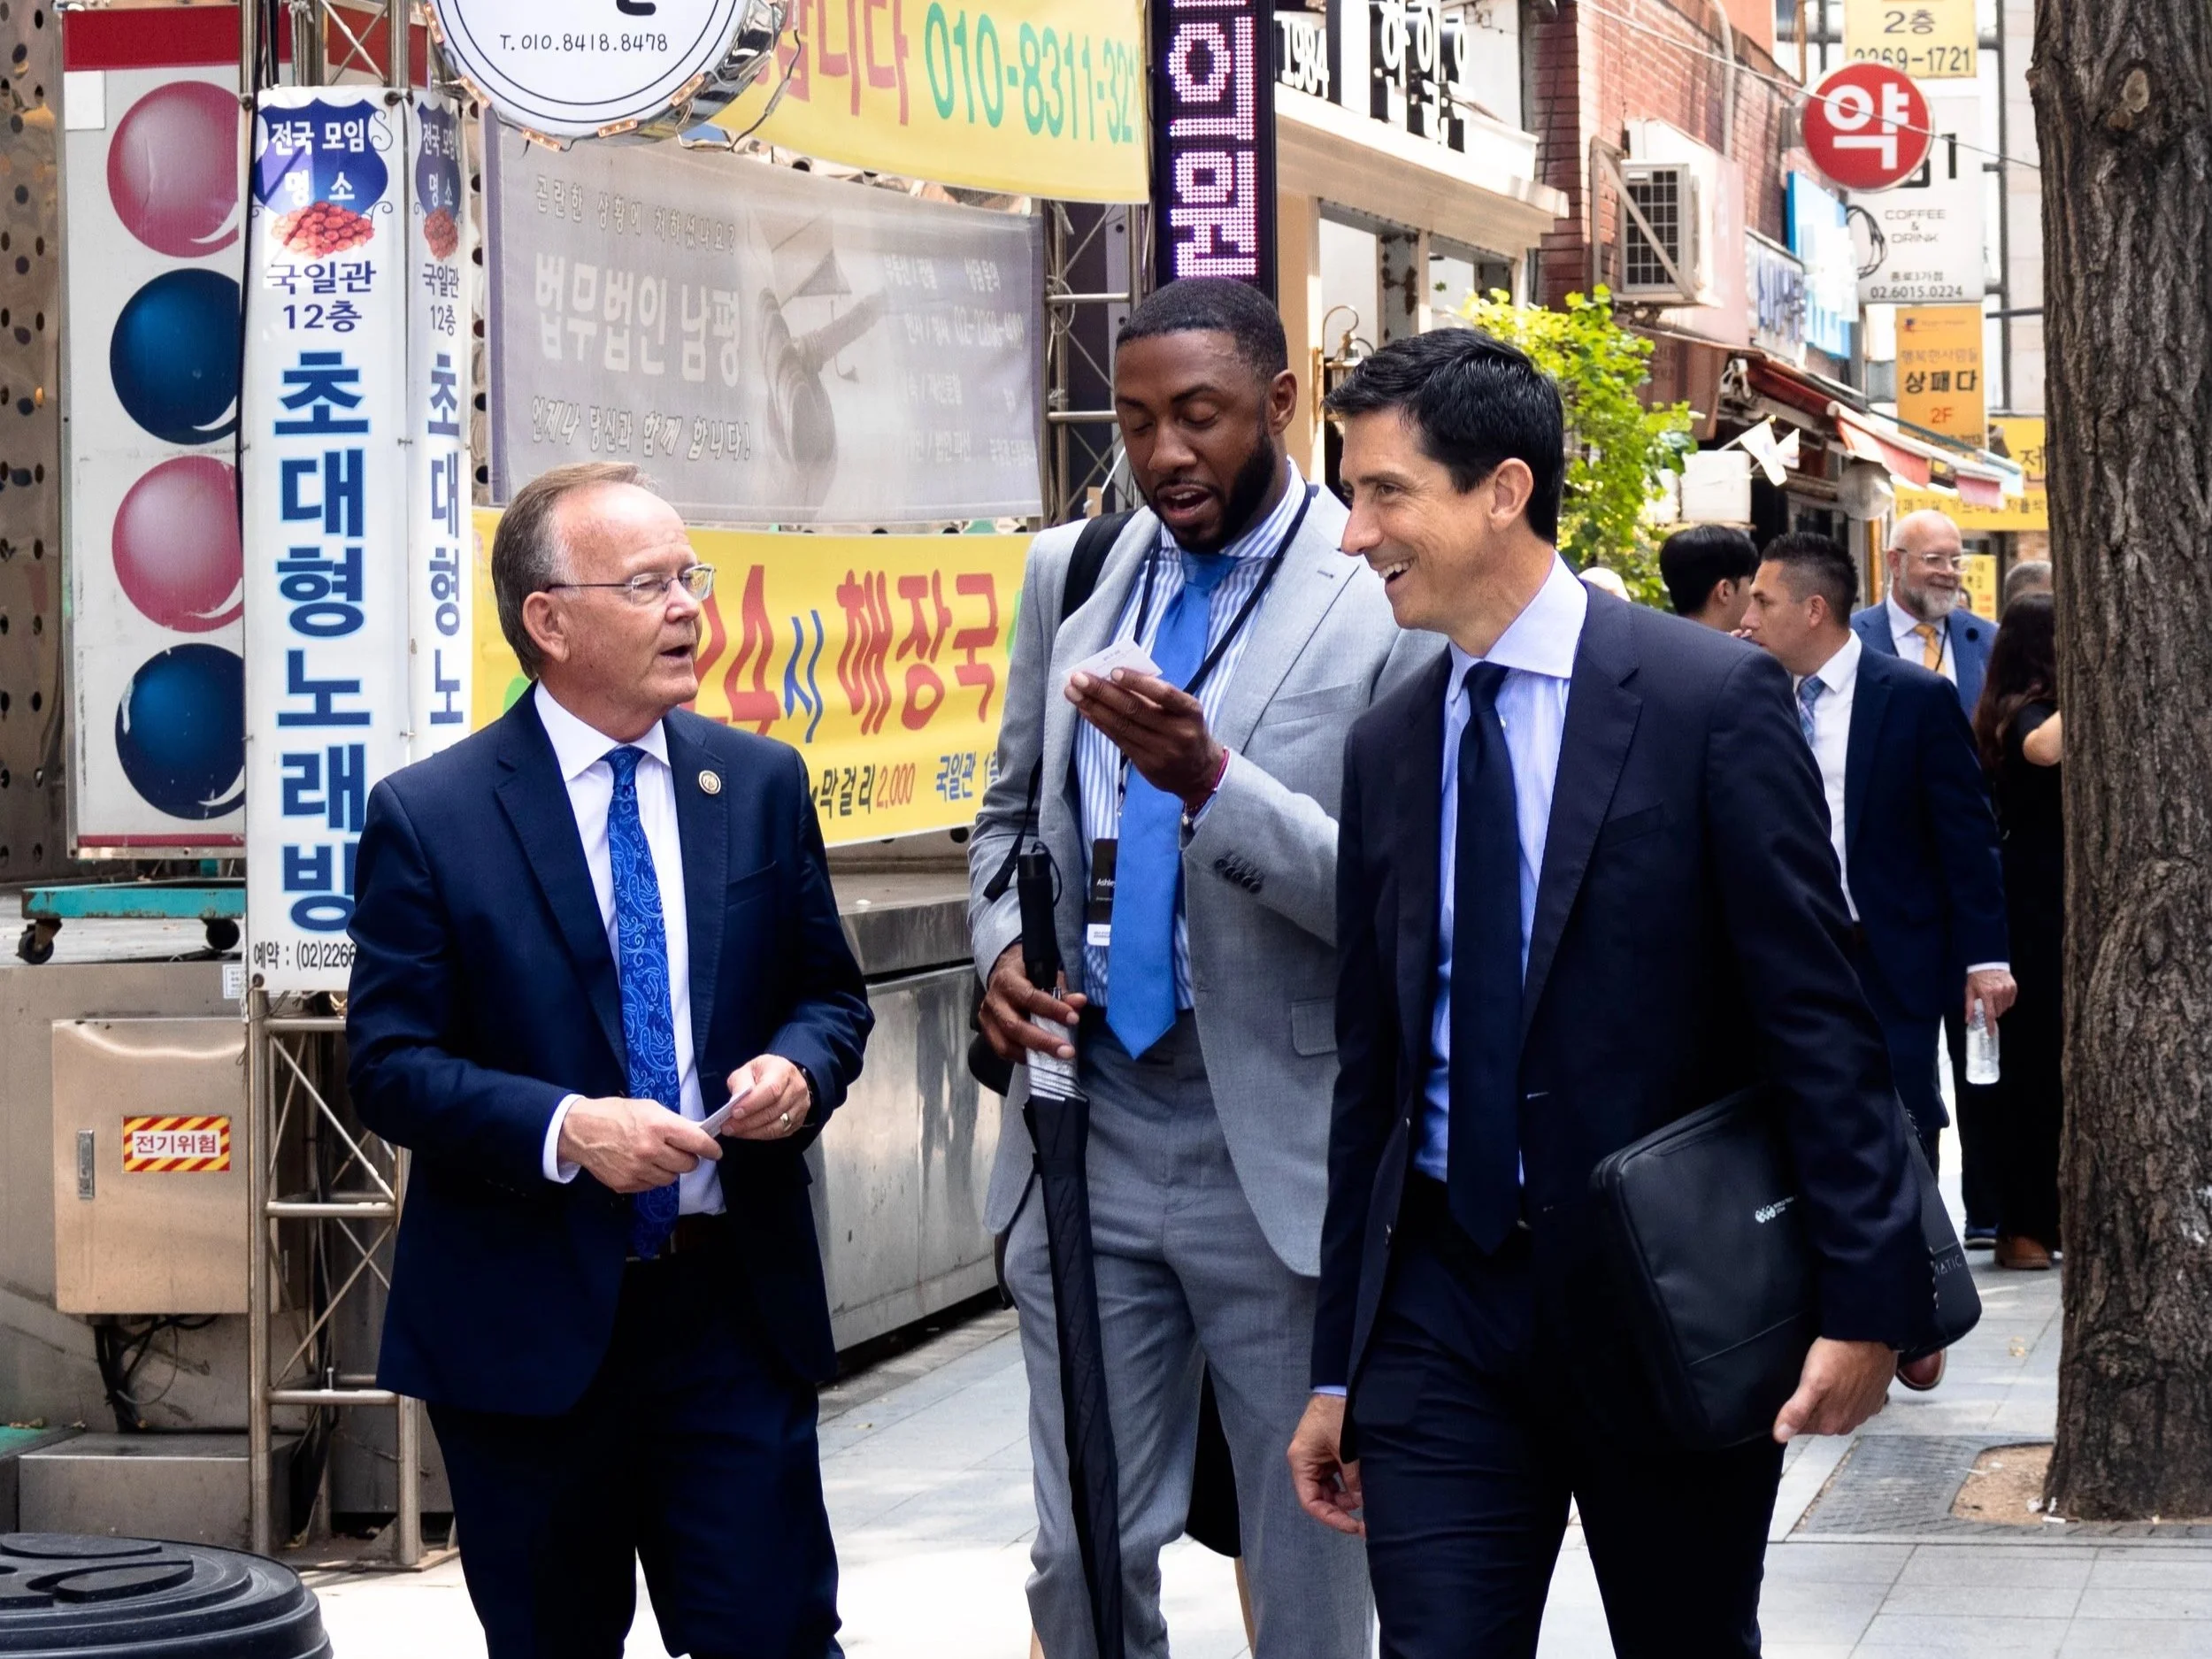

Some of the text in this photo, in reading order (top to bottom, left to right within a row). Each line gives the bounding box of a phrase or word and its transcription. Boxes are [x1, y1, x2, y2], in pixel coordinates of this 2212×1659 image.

[1884, 9, 1935, 35] 2층
[1277, 13, 1329, 99] 1984
[271, 119, 365, 156] 전국 모임
[422, 122, 441, 157] 전국
[1824, 82, 1909, 170] 약
[596, 191, 643, 235] 상황에
[1885, 209, 1947, 220] COFFEE
[1892, 233, 1939, 244] DRINK
[266, 260, 377, 295] 국일관
[423, 263, 459, 299] 국일관
[1870, 286, 1963, 299] 02.6015.0224
[283, 300, 362, 333] 12층
[430, 305, 457, 336] 12층
[534, 251, 741, 388] 법무법인 남평
[1905, 369, 1978, 395] 상패다
[531, 395, 751, 461] 언제나 당신과 함께 합니다!
[1931, 407, 1953, 425] 2F
[428, 352, 463, 754] 초대형노
[836, 569, 999, 736] 해장국
[876, 762, 916, 810] 2,000
[936, 750, 977, 803] 국일관
[253, 941, 280, 970] 예약
[135, 1134, 217, 1155] 전기위험
